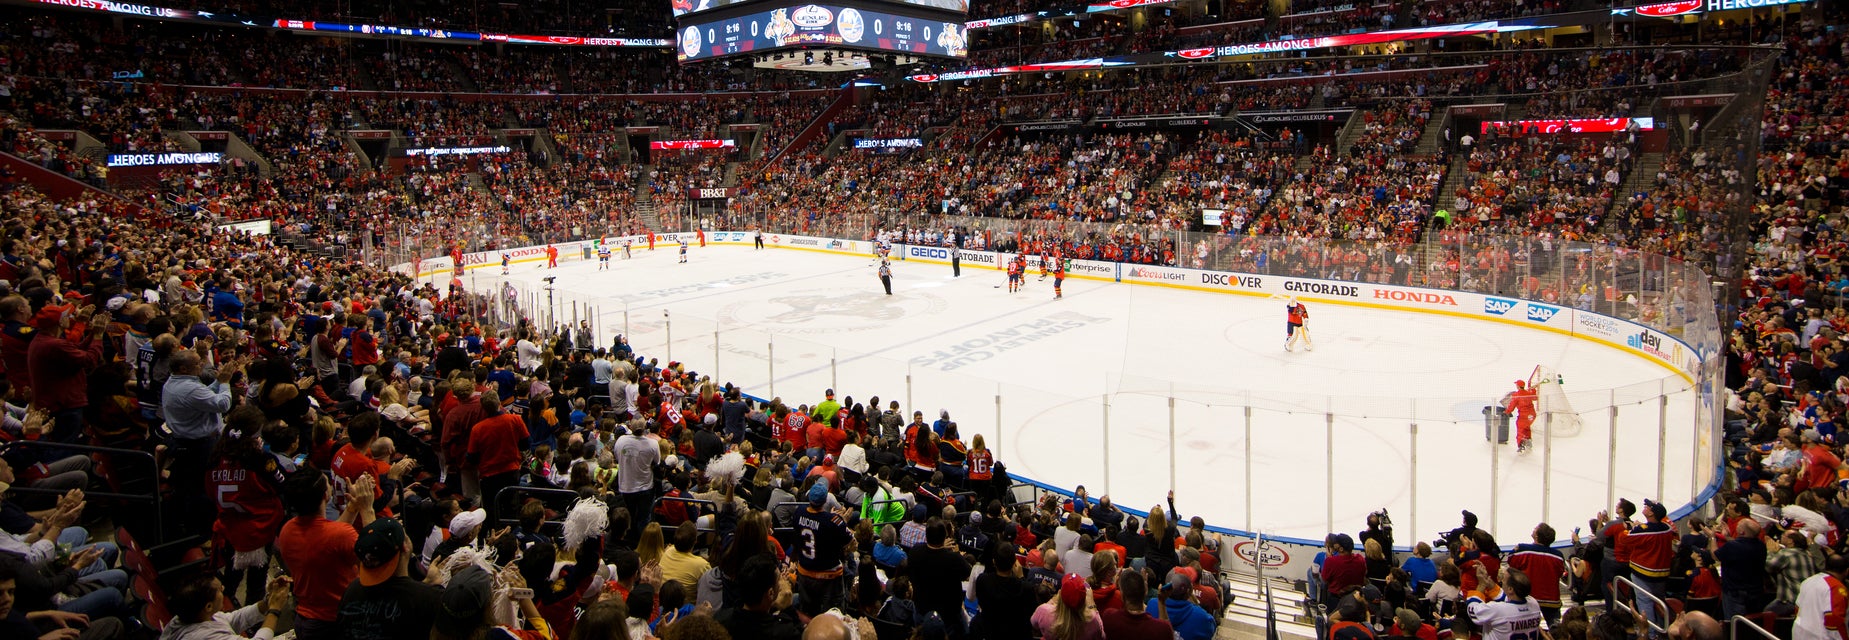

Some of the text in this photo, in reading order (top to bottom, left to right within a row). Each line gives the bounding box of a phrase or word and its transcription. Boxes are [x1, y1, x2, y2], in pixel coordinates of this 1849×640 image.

[101, 2, 152, 16] AMONG
[156, 8, 173, 17] US
[875, 19, 882, 35] 0
[896, 22, 912, 32] 9:16
[986, 17, 1014, 26] AMONG
[1015, 14, 1025, 22] US
[709, 28, 715, 43] 0
[726, 23, 740, 34] 9:16
[751, 21, 759, 36] 0
[924, 26, 931, 41] 0
[584, 38, 617, 46] HEROES
[1217, 44, 1260, 56] HEROES
[1263, 39, 1310, 53] AMONG
[1314, 36, 1330, 48] US
[940, 71, 967, 81] HEROES
[113, 152, 219, 166] HEROES AMONG US
[700, 189, 728, 198] BB&T
[911, 247, 948, 259] GEICO
[959, 252, 994, 263] ATORADE
[1138, 267, 1186, 281] Coors LIGHT
[1202, 273, 1263, 289] DISCOVER
[1284, 281, 1359, 297] GATORADE
[1373, 288, 1459, 306] HONDA
[1485, 300, 1512, 313] SAP
[1528, 305, 1554, 320] SAP
[1580, 314, 1616, 327] WORLD CUP
[1580, 320, 1605, 333] HOCKEY
[1628, 329, 1661, 352] all day
[1643, 345, 1672, 361] BREAKFAST
[788, 414, 804, 429] 68
[973, 458, 988, 474] 16
[212, 469, 247, 482] EKBLAD
[217, 484, 246, 513] 5
[801, 528, 816, 560] 3
[1509, 618, 1540, 632] TAVARES
